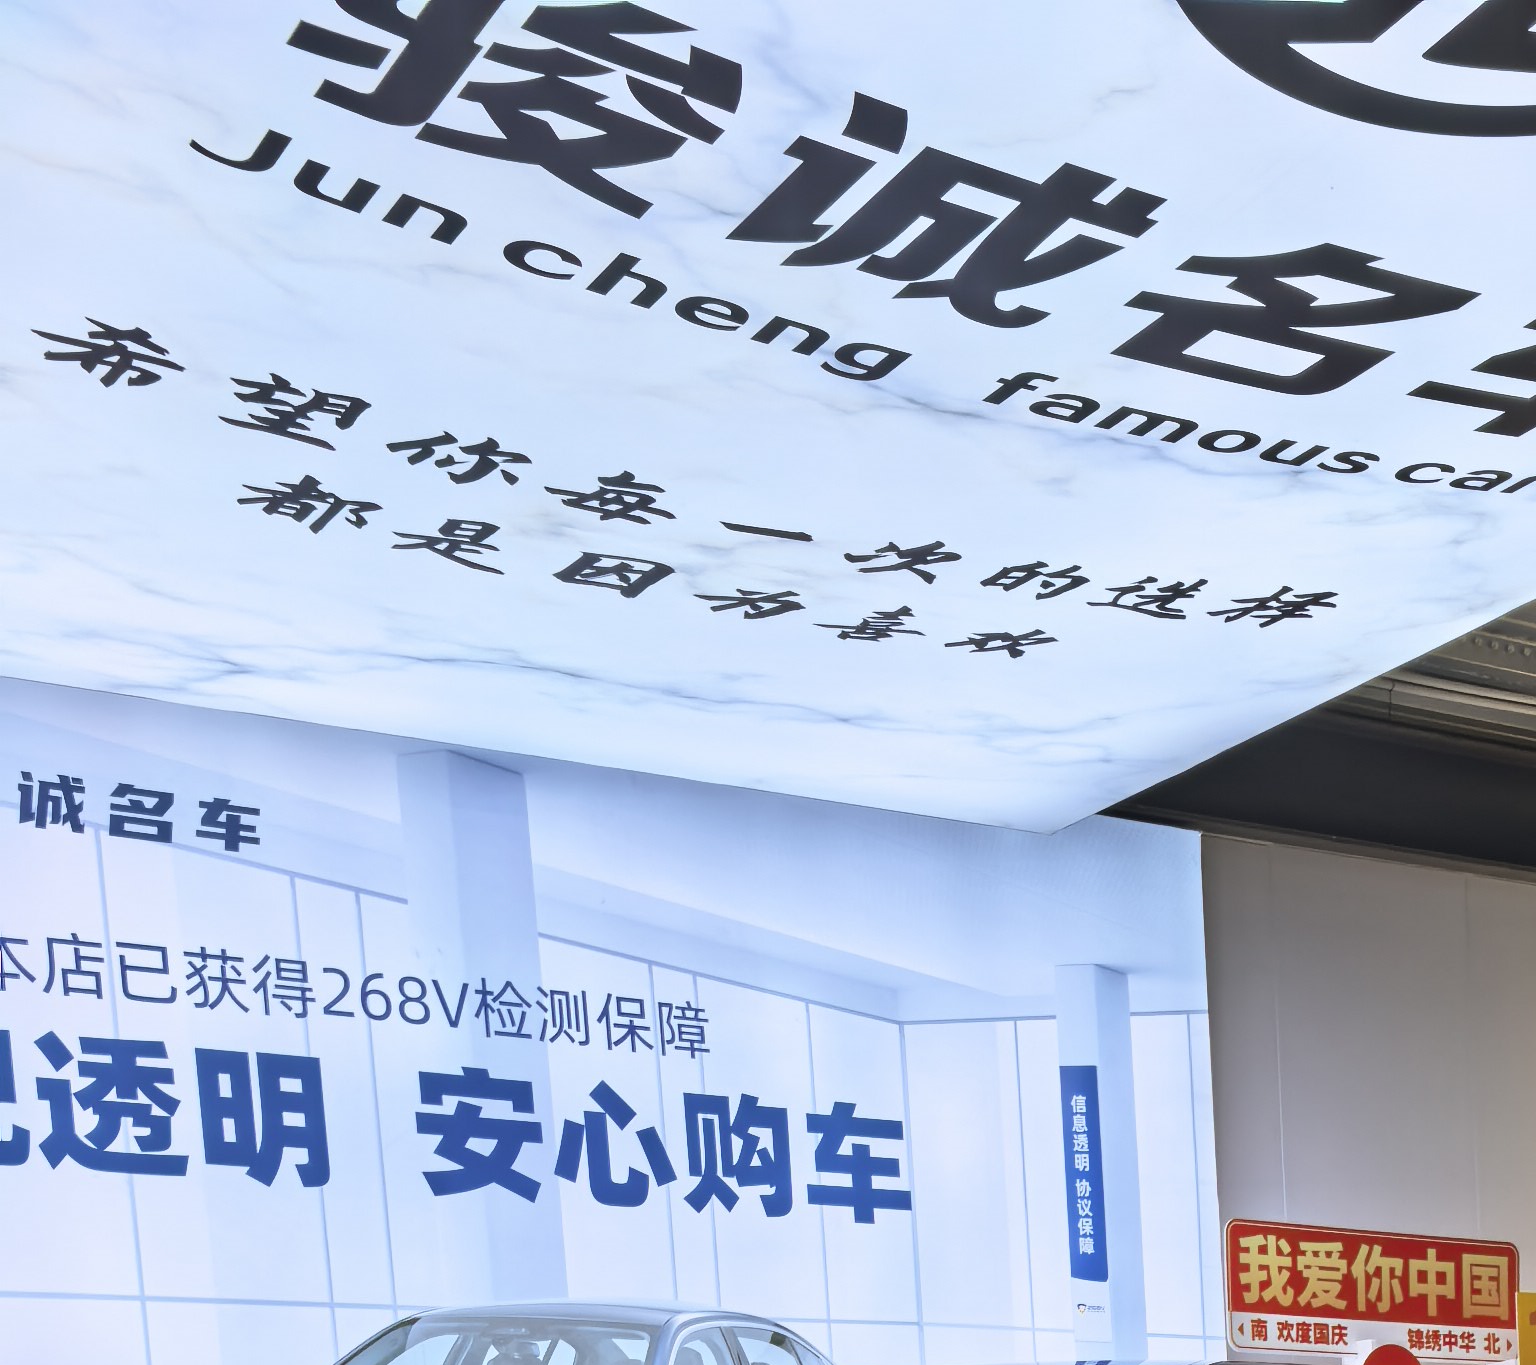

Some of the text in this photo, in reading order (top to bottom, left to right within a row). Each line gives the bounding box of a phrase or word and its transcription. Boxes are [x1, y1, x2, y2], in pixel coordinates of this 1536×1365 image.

[189, 129, 468, 245] Jun
[502, 240, 912, 381] cheng
[982, 371, 1382, 475] famous
[31, 315, 1338, 628] 希望你每一次的选择
[237, 474, 1059, 658] 都是因为喜欢
[18, 771, 262, 853] 诚名车
[414, 1066, 914, 1224] 安心购车
[1070, 1094, 1095, 1256] 信息透明 协议保障
[1238, 1234, 1510, 1321] 我爱你中国
[1250, 1318, 1501, 1356] 南 欢度国庆 锦绣中华 北
